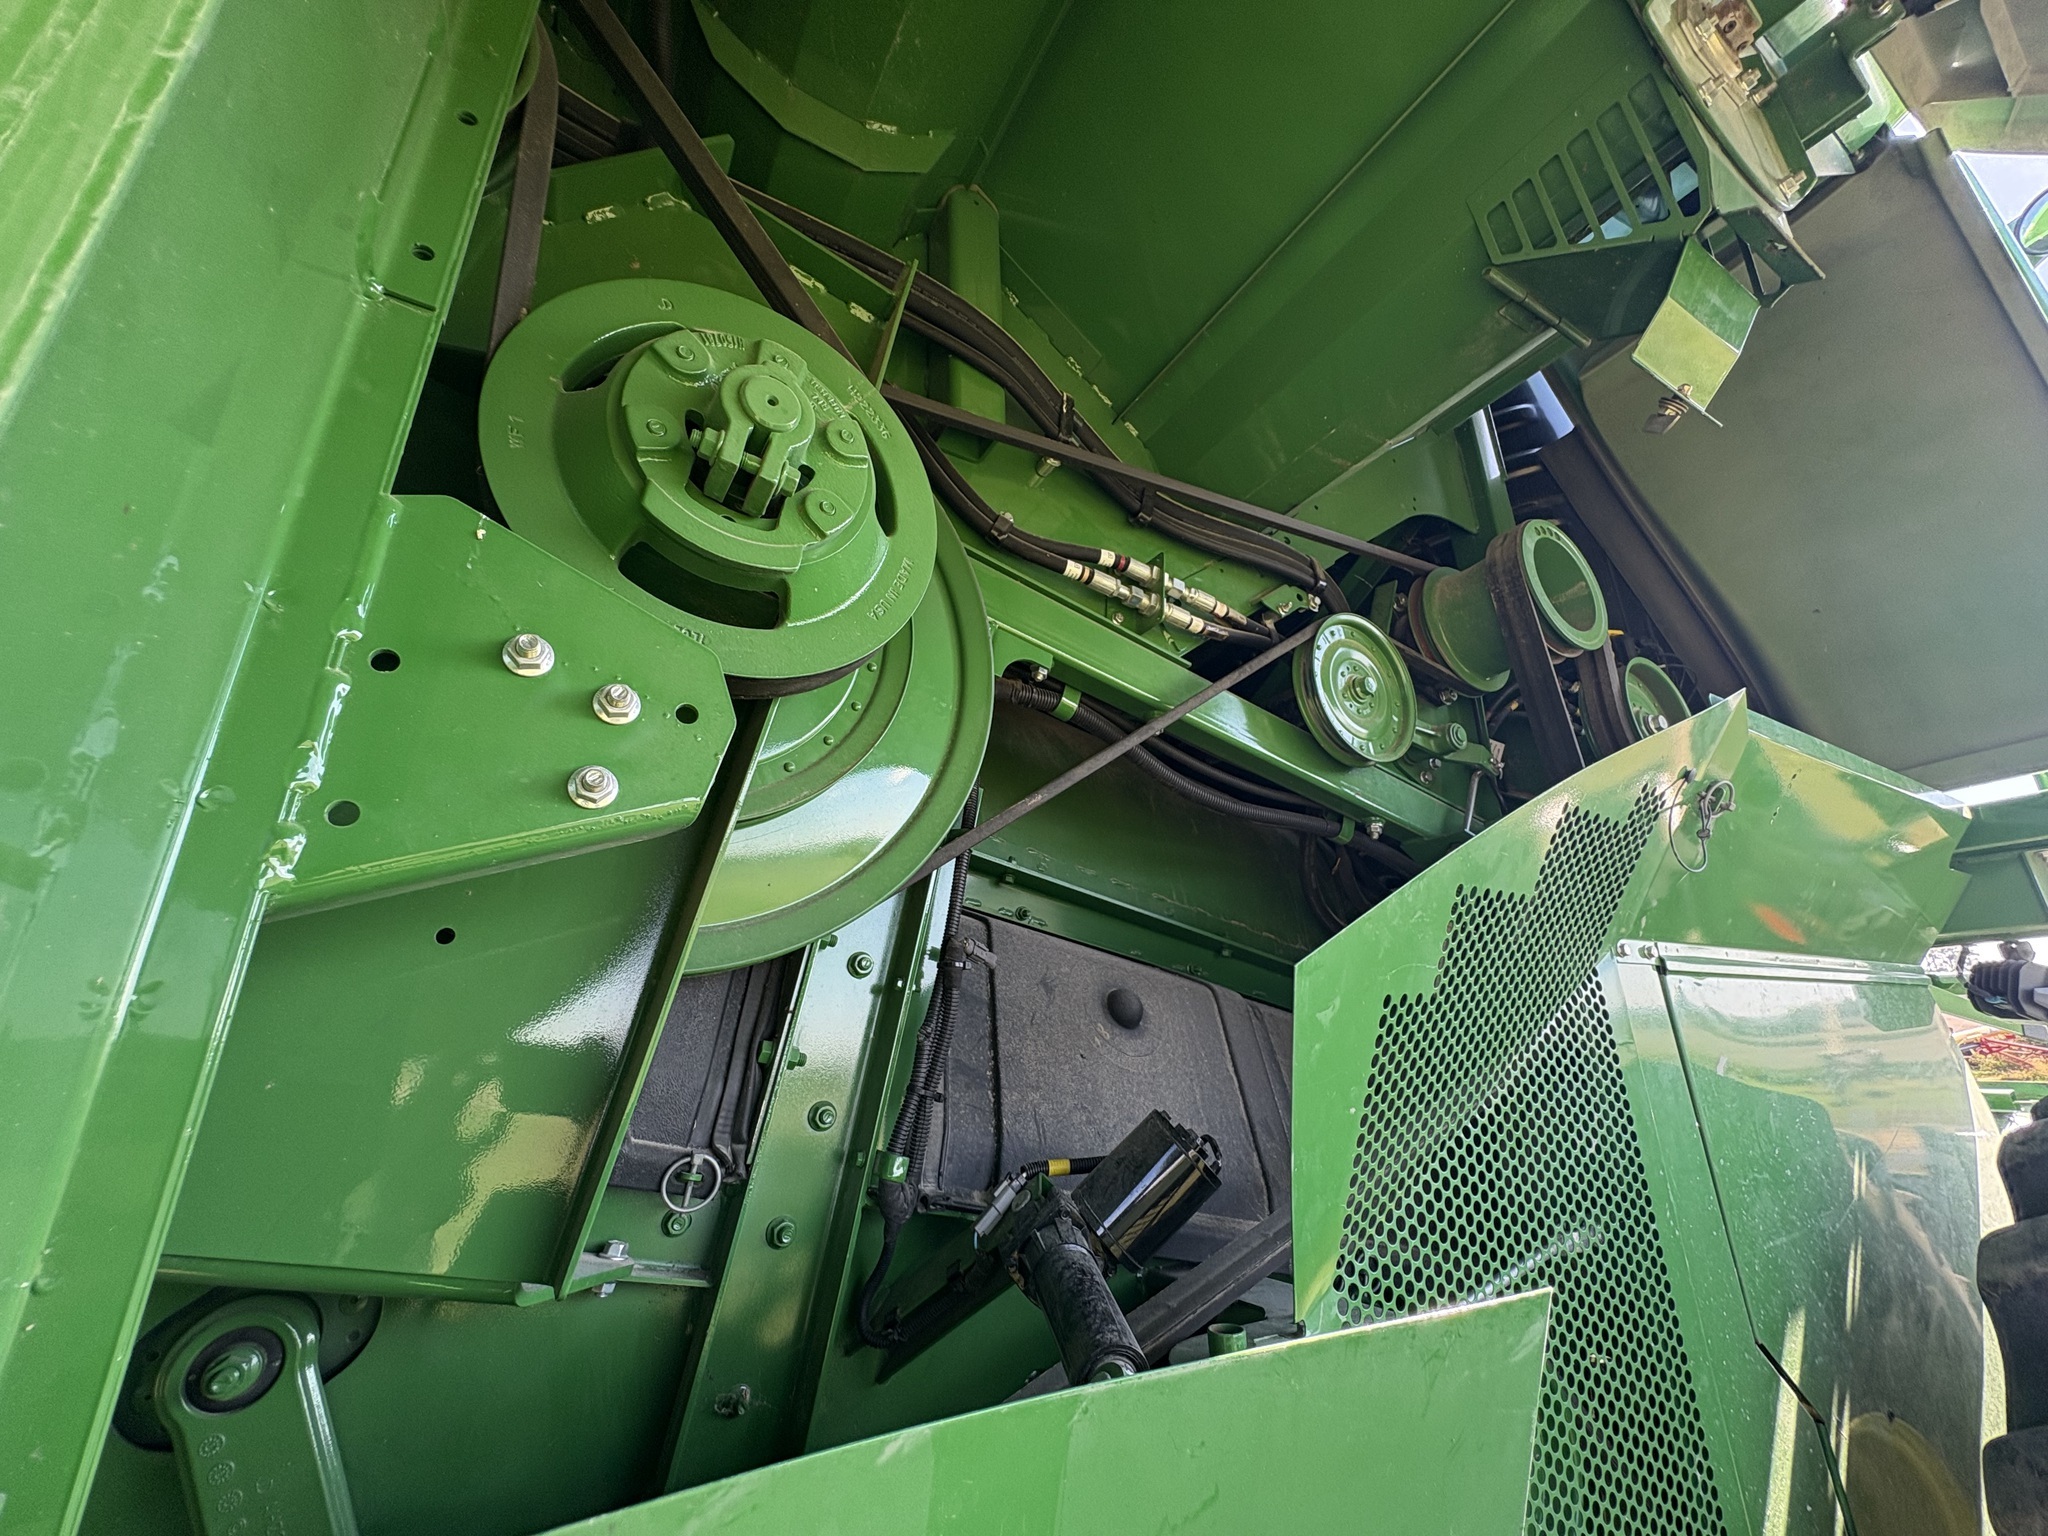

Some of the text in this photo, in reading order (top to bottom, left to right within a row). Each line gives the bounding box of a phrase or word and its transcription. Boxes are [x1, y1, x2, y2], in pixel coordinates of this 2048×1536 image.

[867, 557, 915, 621] MADE IN USA
